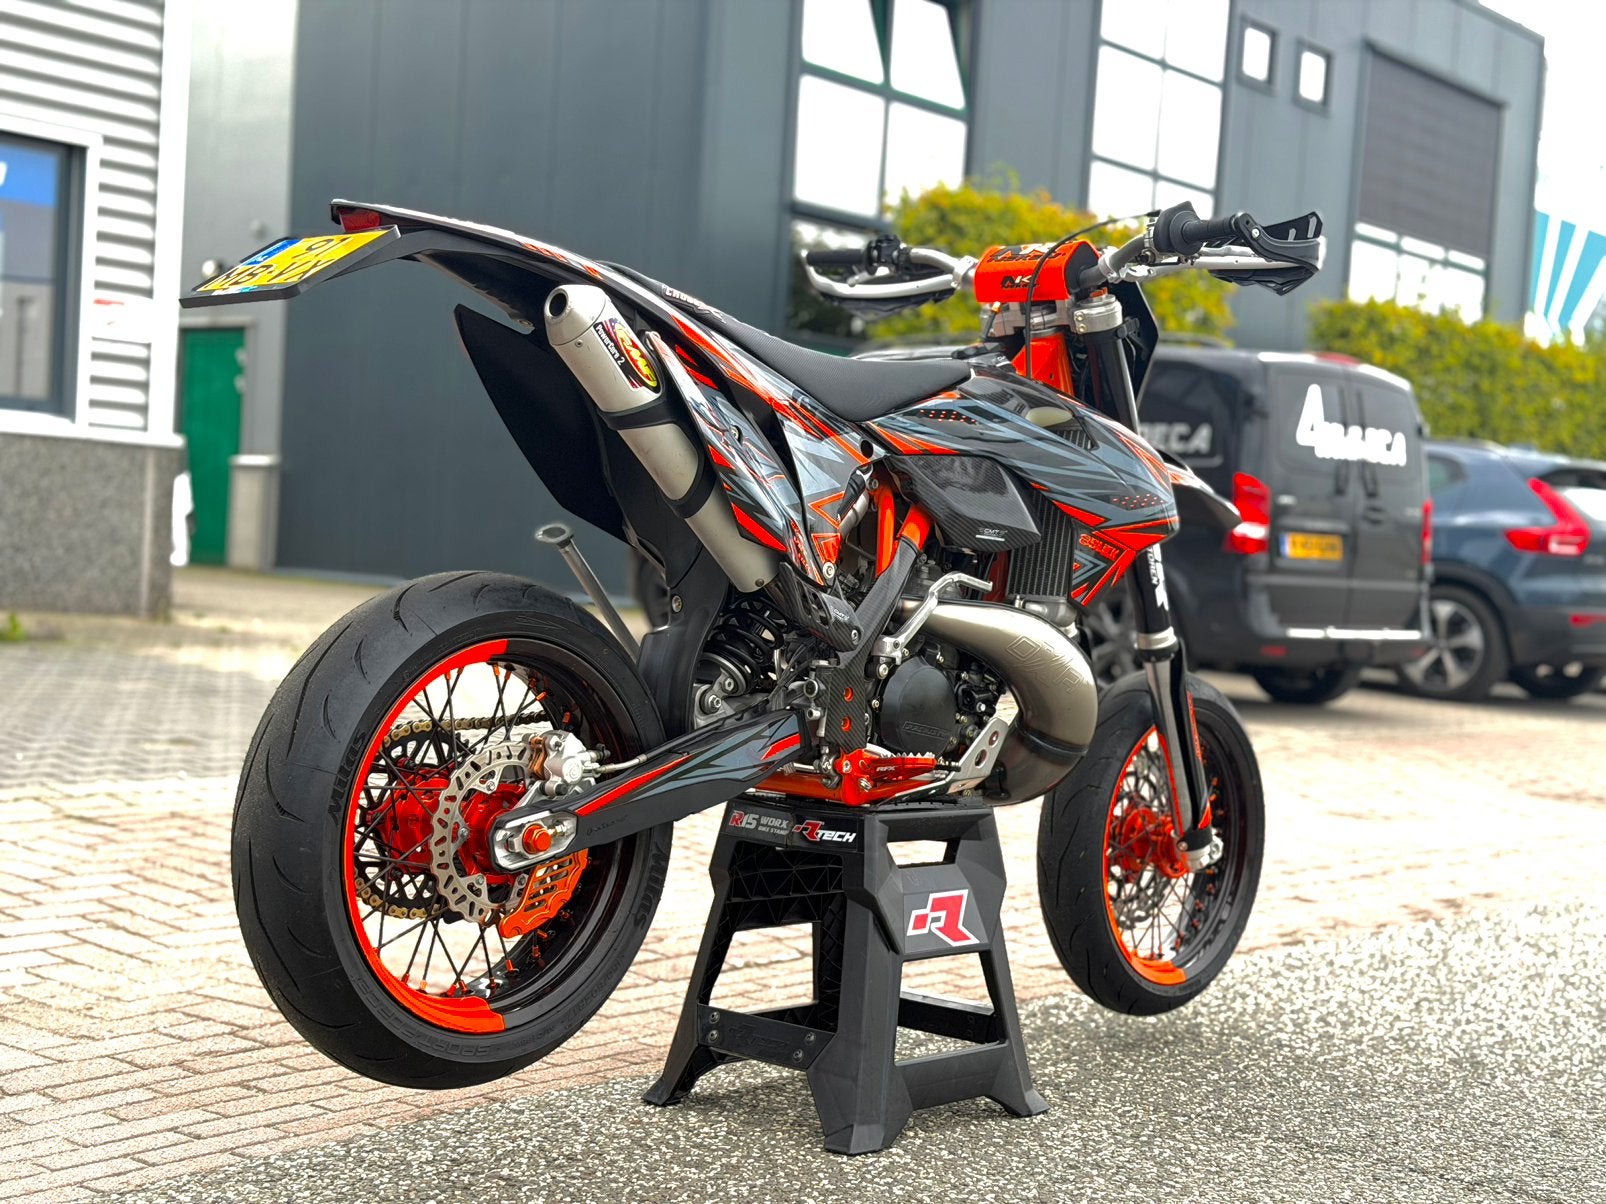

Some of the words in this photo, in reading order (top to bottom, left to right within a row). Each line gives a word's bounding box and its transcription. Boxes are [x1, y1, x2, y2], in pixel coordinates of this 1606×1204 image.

[291, 236, 352, 260] 91
[615, 328, 657, 384] FMF
[617, 356, 626, 366] 2
[327, 731, 366, 828] Mitas
[729, 809, 759, 829] R15
[760, 815, 789, 829] WORX
